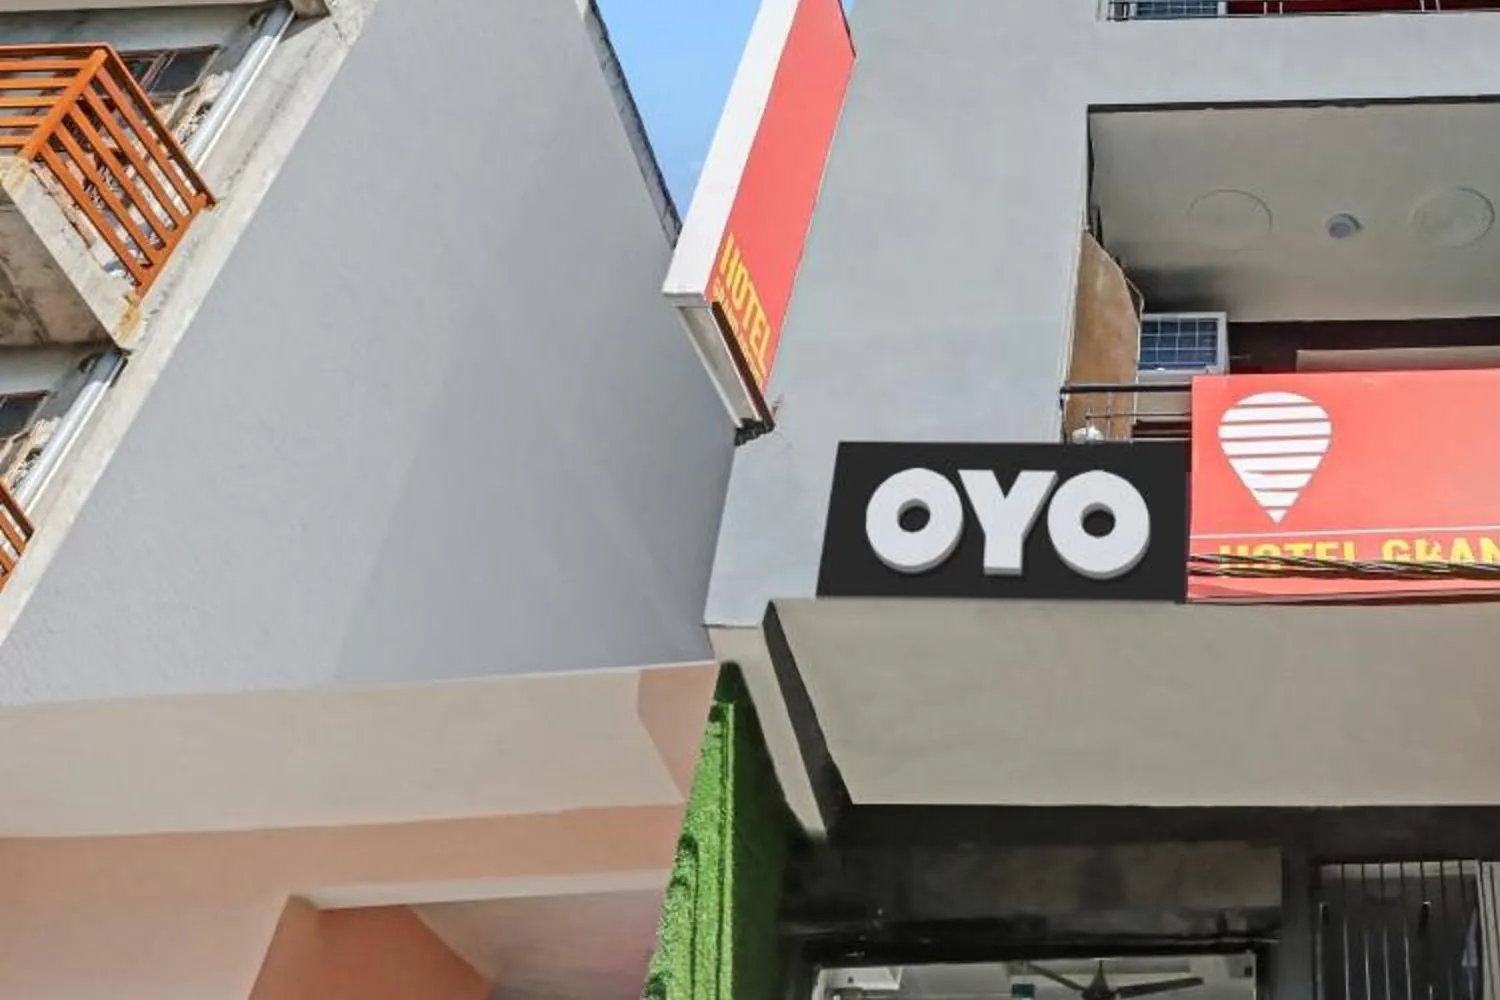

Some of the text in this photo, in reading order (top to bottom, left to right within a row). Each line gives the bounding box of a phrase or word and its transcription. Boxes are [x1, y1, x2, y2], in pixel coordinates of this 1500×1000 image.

[719, 231, 769, 379] HOTEL
[865, 467, 1151, 580] OYO
[1218, 538, 1356, 569] HOTEL
